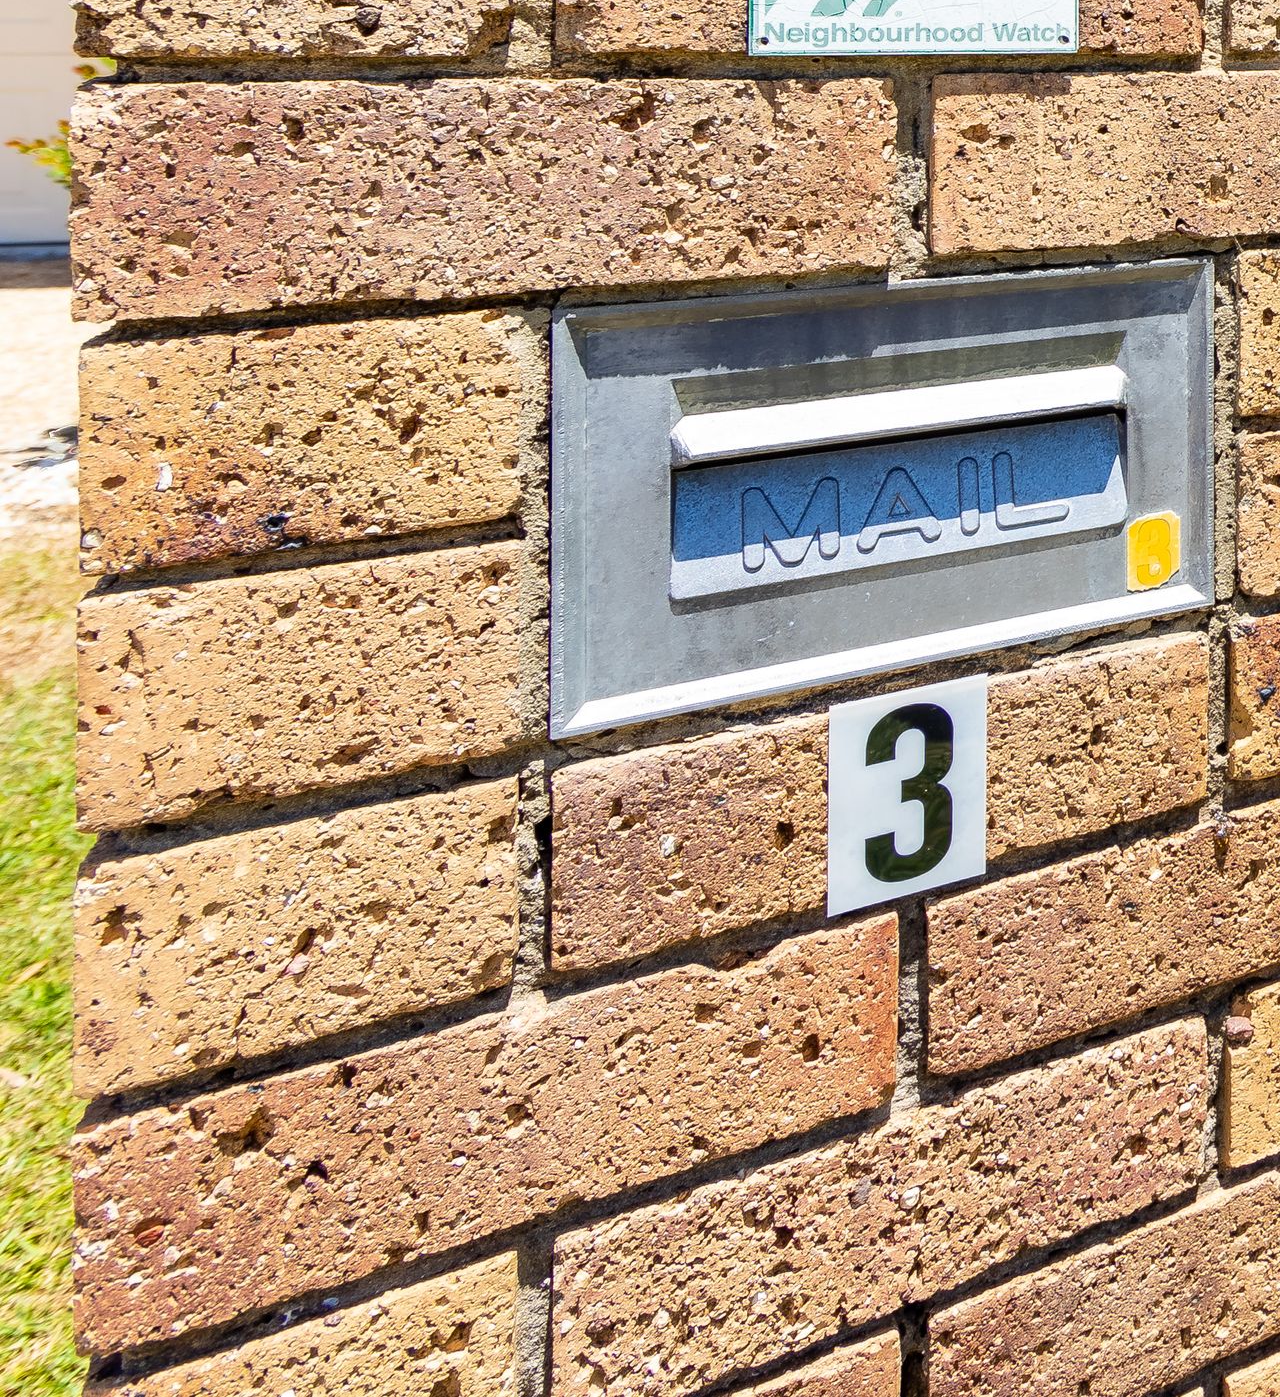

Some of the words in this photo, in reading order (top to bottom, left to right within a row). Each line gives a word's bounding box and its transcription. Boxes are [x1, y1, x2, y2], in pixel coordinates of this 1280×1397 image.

[764, 22, 984, 47] Neighbourhood
[991, 22, 1070, 43] Watch
[741, 451, 1069, 573] MAIL
[1136, 518, 1171, 587] 3
[864, 702, 954, 883] 3
